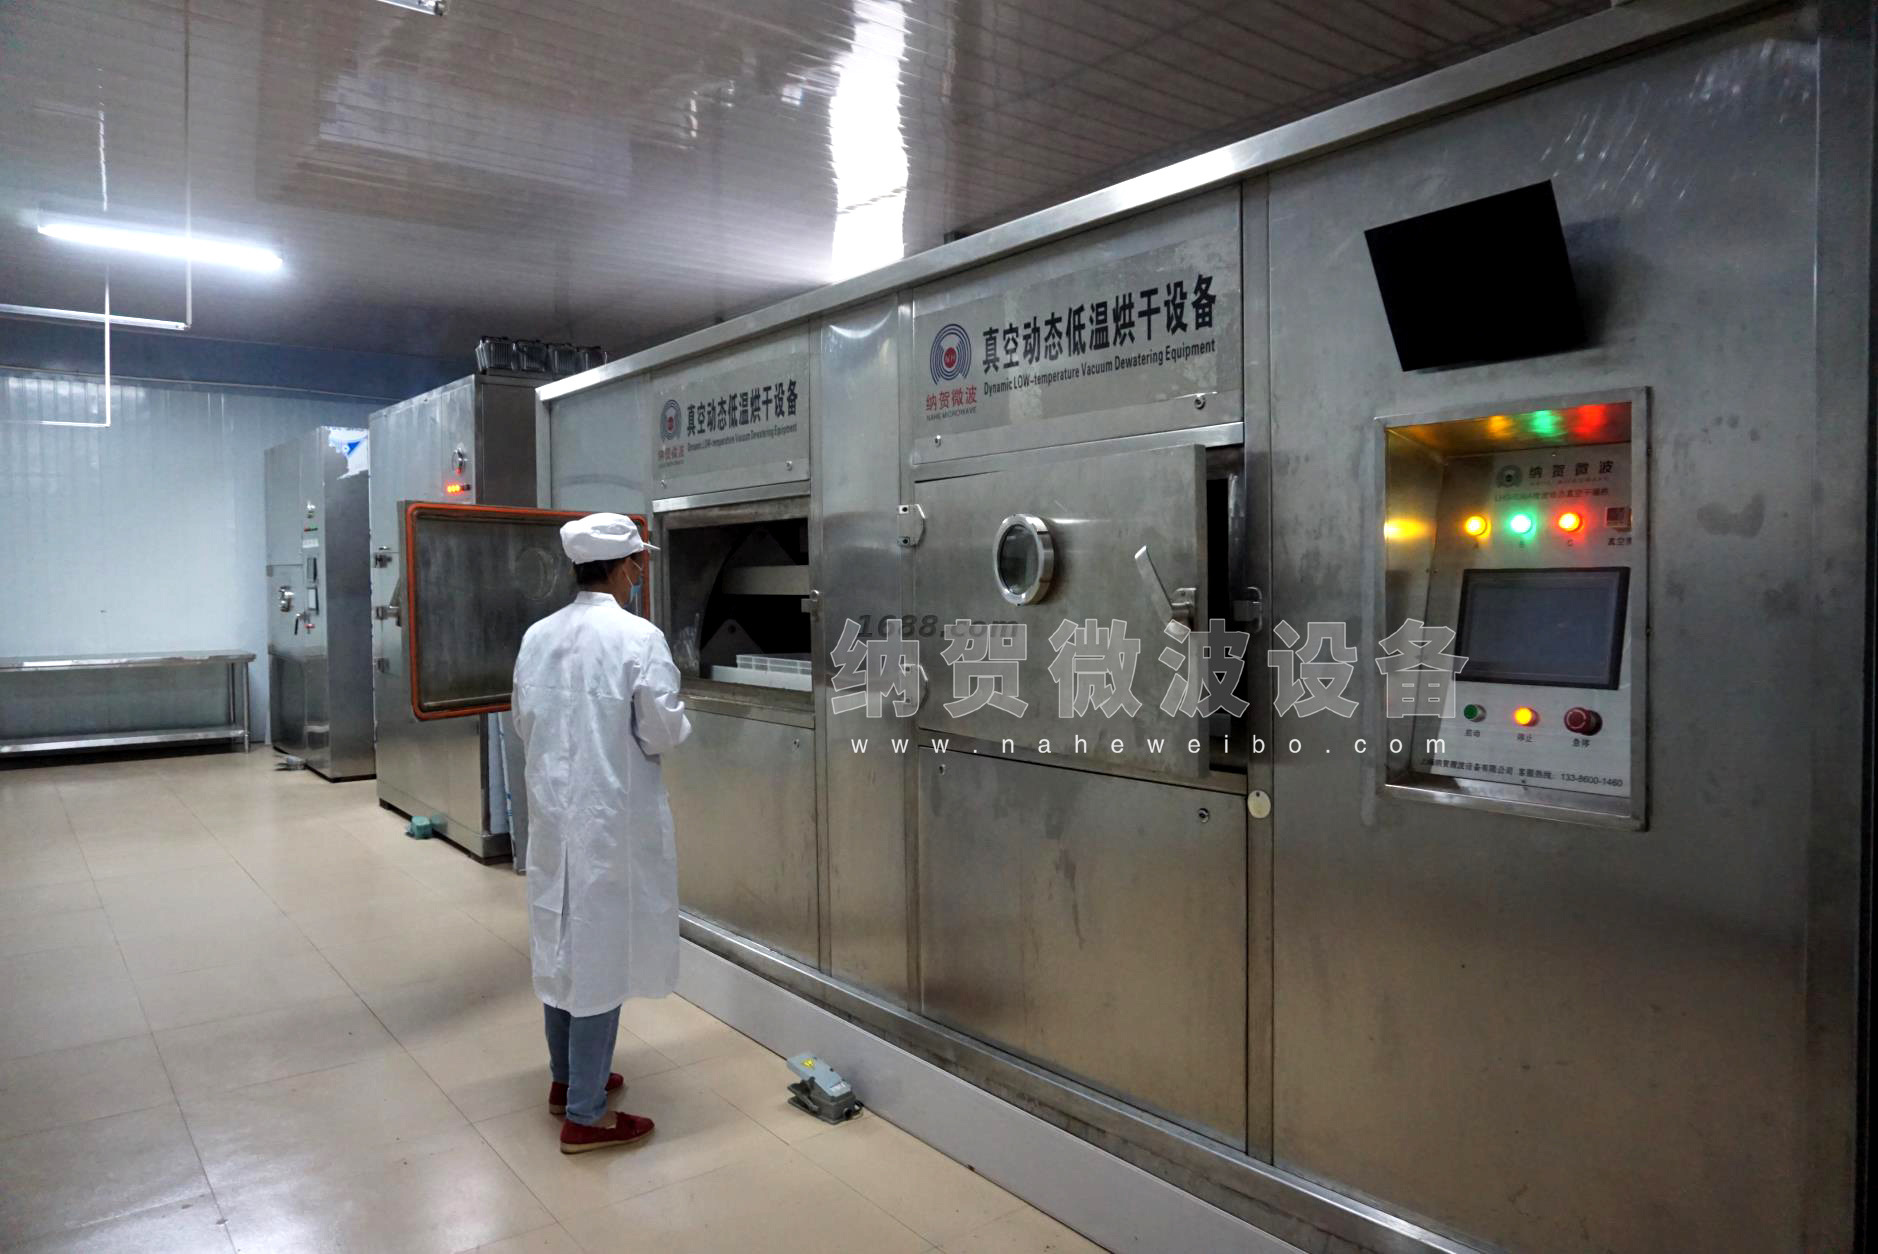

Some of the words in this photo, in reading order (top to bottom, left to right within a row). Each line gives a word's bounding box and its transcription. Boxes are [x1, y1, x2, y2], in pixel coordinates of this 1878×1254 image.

[982, 273, 1217, 374] 真空动态低温烘干设备
[984, 378, 1013, 396] Dynamic
[1013, 366, 1080, 390] LOW-temperature
[1081, 360, 1113, 377] Vacuum
[1114, 349, 1164, 371] Dewatering
[1165, 339, 1216, 362] Equipment
[686, 379, 798, 437] 真空动态低温烘干设备
[926, 384, 977, 411] 纳贺微波
